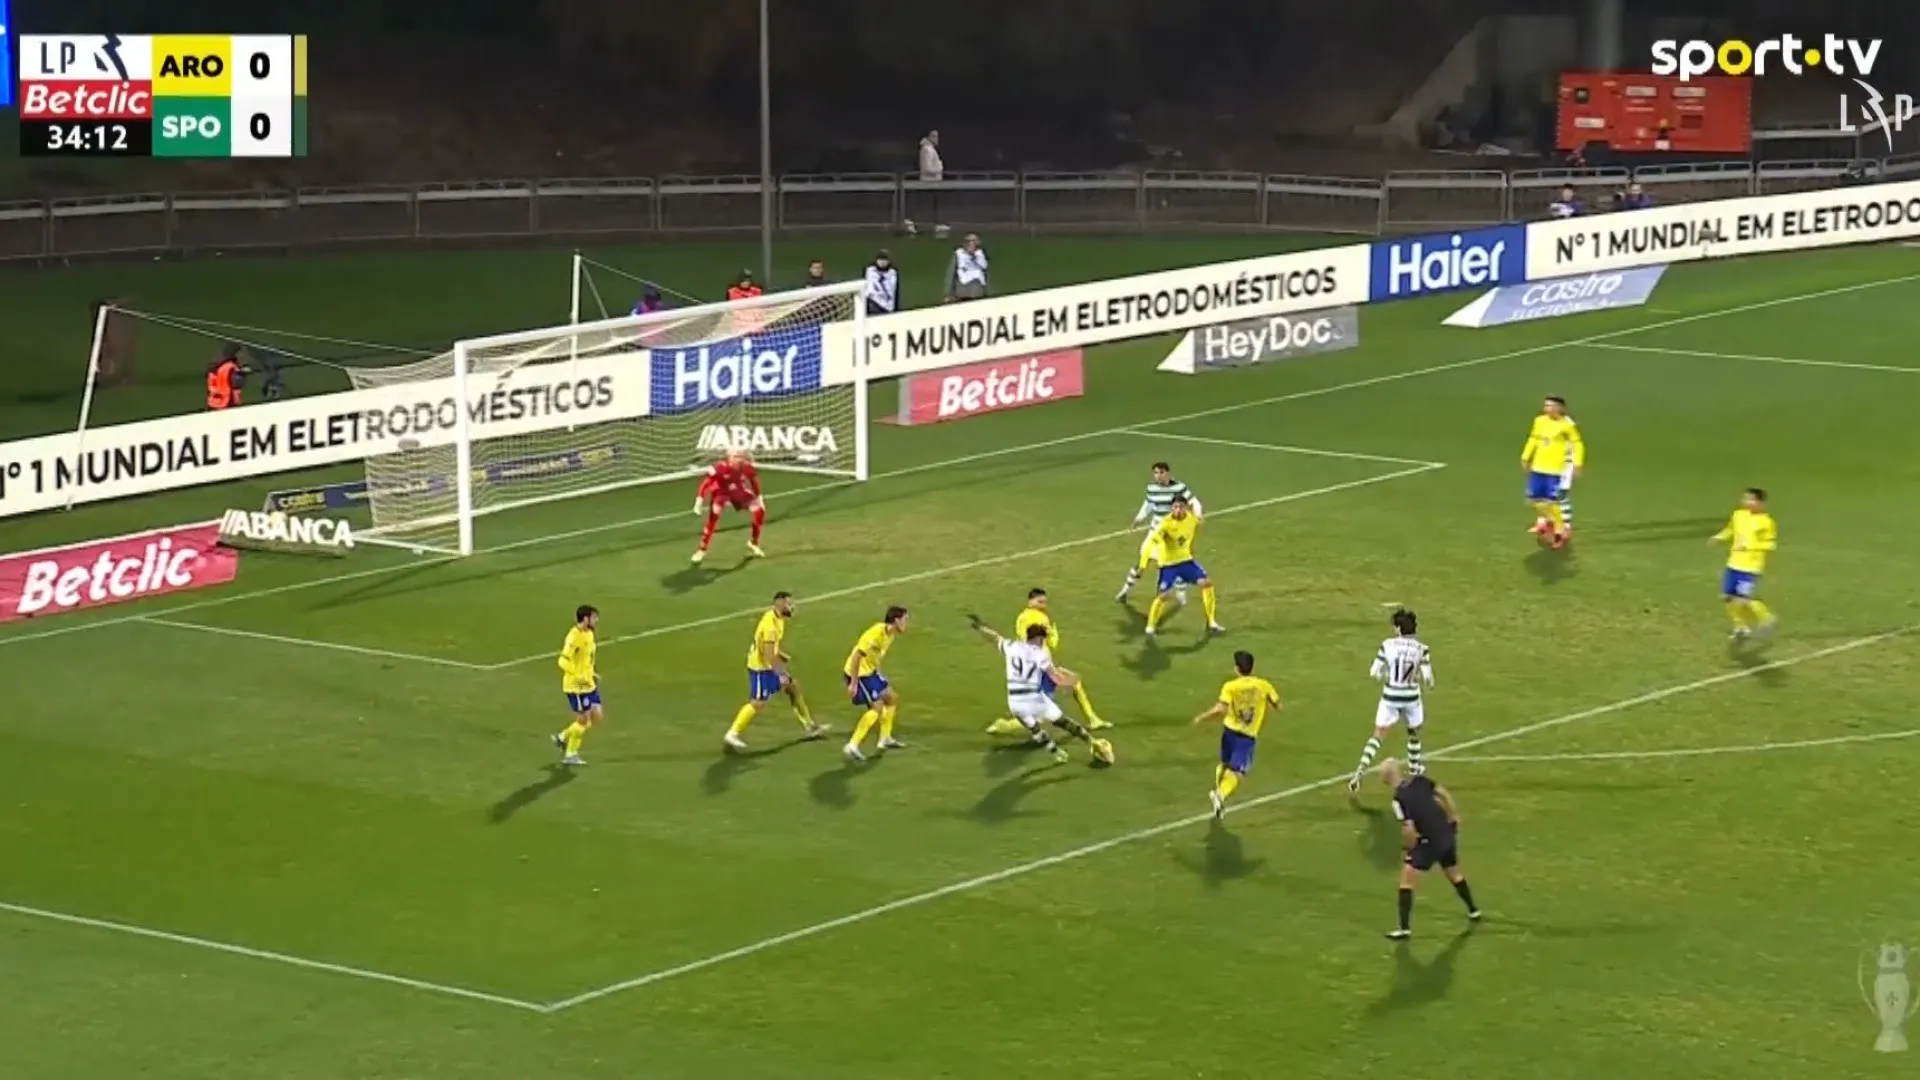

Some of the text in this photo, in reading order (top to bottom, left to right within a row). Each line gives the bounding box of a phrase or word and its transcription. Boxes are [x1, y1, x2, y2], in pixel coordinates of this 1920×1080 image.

[1593, 233, 1602, 260] 1
[1609, 221, 1729, 258] MUNDIAL
[1736, 213, 1774, 242] EM
[1782, 197, 1920, 237] ELETRODO
[1389, 235, 1504, 294] Haier
[888, 332, 897, 361] 1
[906, 311, 1025, 358] MUNDIAL
[1032, 306, 1068, 338] EM
[1077, 266, 1337, 331] ELETRODOMÉSTICOS
[1205, 316, 1333, 362] HeyDoc
[674, 337, 798, 405] Haier
[938, 361, 1056, 417] Betclic
[31, 459, 43, 493] 1
[56, 433, 219, 490] MUNDIAL
[229, 423, 277, 462] EM
[288, 374, 613, 452] ELETRODOMÉSTICOS
[16, 538, 198, 614] Betclic
[1011, 656, 1037, 680] 97
